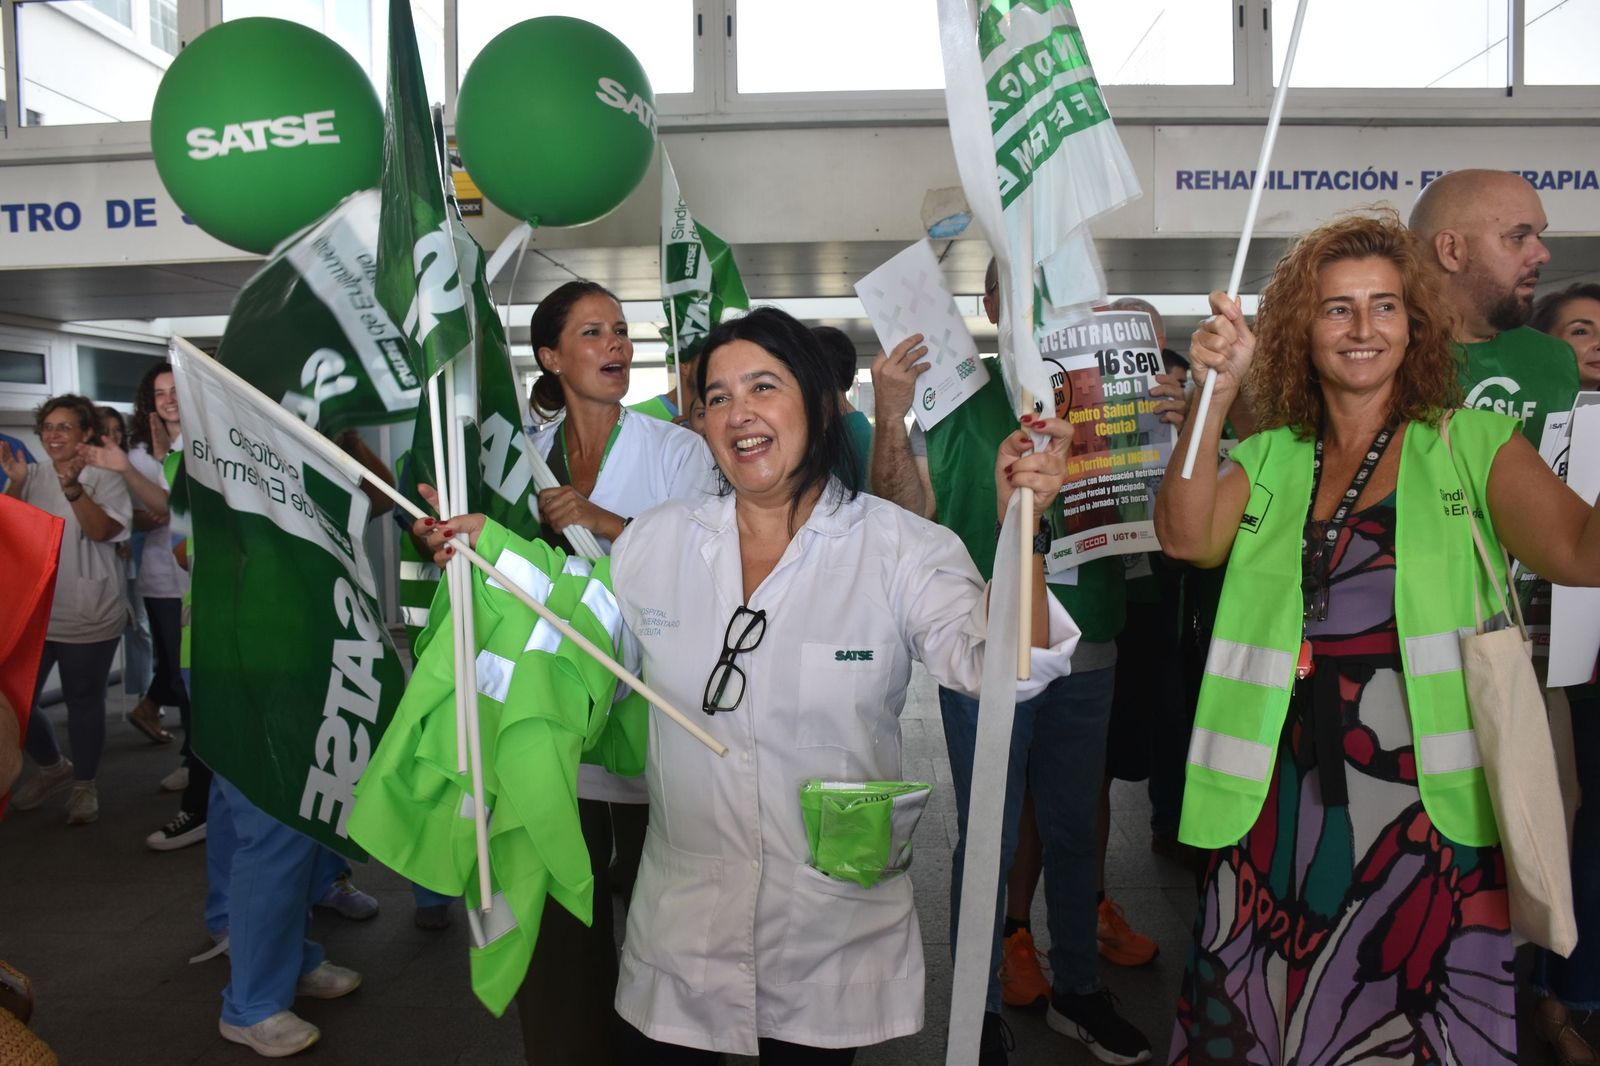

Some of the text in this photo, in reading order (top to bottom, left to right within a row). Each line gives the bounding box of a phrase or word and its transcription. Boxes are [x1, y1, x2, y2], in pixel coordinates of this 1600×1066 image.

[186, 109, 341, 161] SATSE
[106, 198, 157, 229] DE
[685, 243, 697, 278] SATSE
[1094, 348, 1160, 377] 16 Sep
[1102, 380, 1131, 397] 11:00
[1068, 407, 1100, 424] Centro
[1103, 401, 1135, 418] Salud
[1095, 419, 1136, 437] (Ceuta)
[1081, 455, 1126, 472] Territorial
[1098, 471, 1134, 483] Adecuación
[1087, 487, 1106, 498] Parcial
[1112, 482, 1145, 493] Anticipada
[1092, 497, 1115, 508] Jornada
[1130, 494, 1149, 503] horas
[1084, 536, 1106, 548] CCOO
[1113, 532, 1130, 541] UGT
[1053, 547, 1073, 559] SATSE
[835, 650, 874, 661] SATSE
